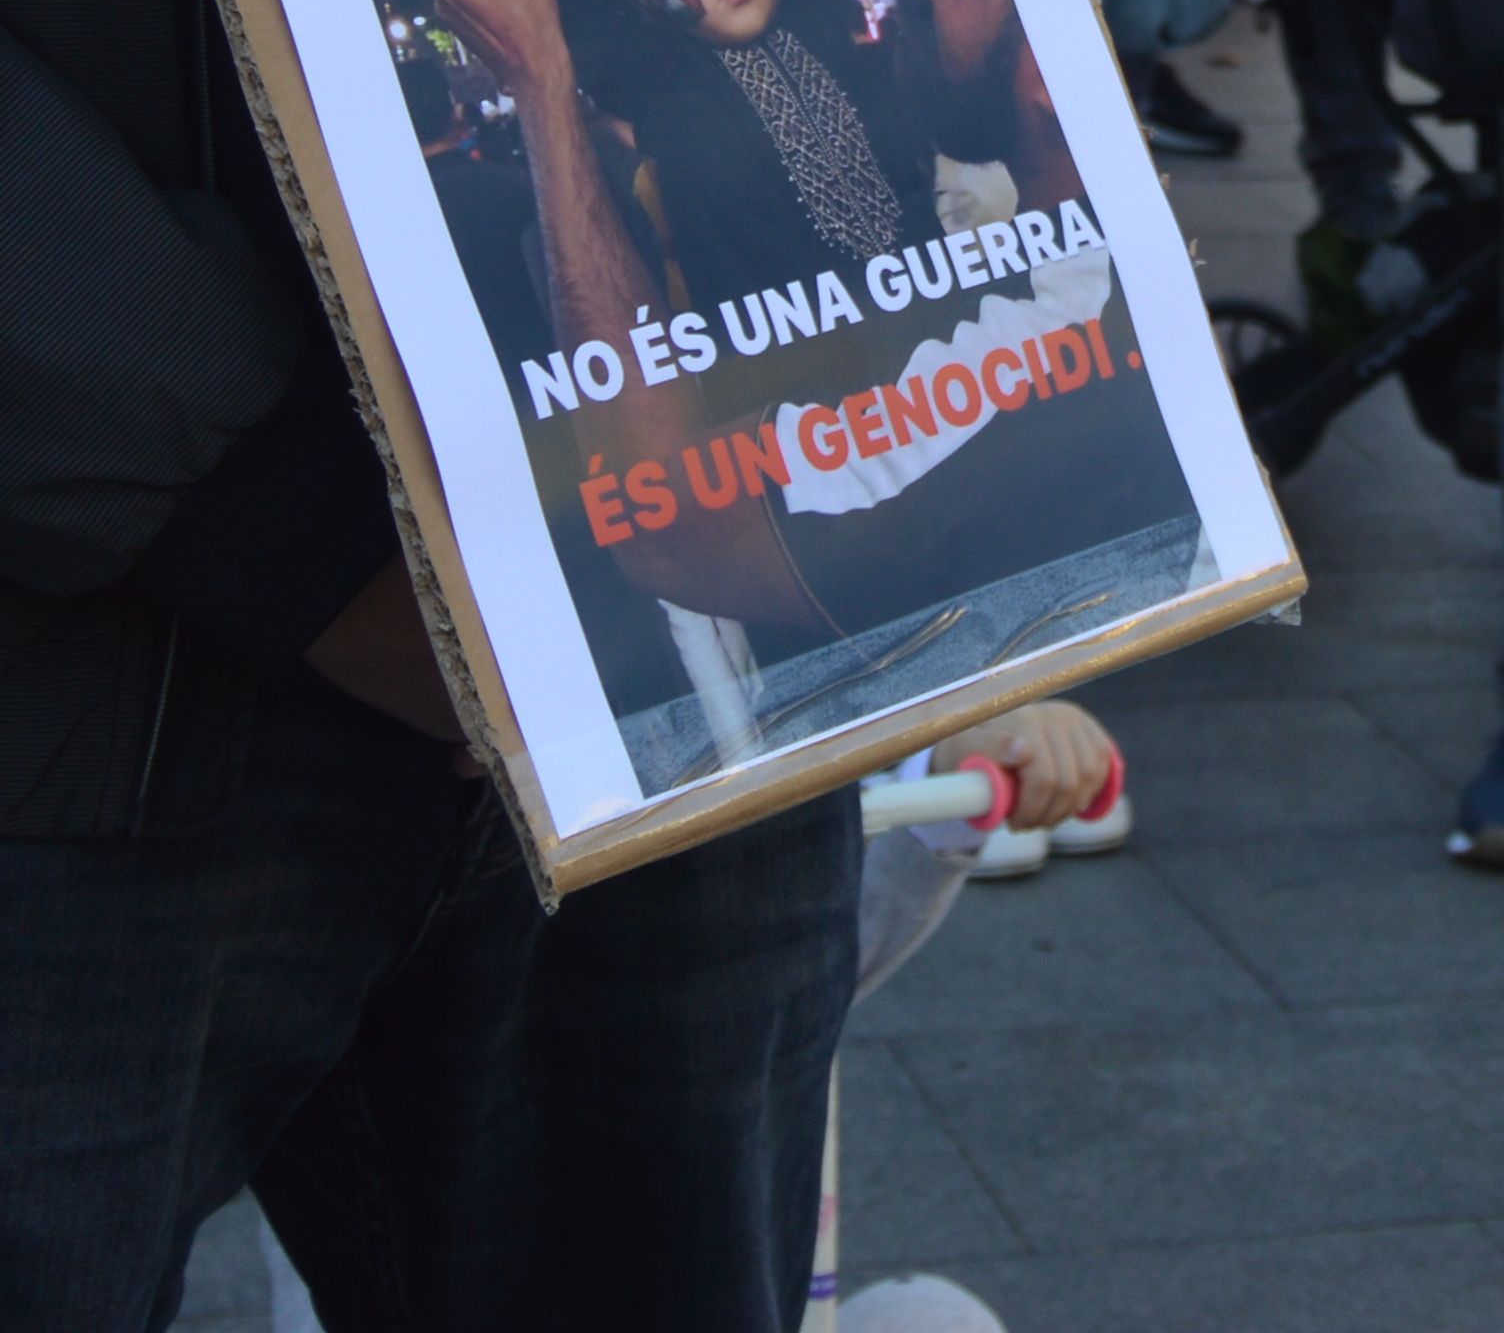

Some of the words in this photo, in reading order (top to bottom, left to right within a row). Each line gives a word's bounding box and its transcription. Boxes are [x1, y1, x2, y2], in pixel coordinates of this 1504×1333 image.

[521, 339, 625, 421] NO
[628, 304, 718, 387] ÉS
[718, 269, 864, 357] UNA
[864, 197, 1108, 314] GUERRA
[578, 454, 679, 548] ÉS
[681, 421, 792, 511] UN
[797, 317, 1116, 473] GENOCIDI
